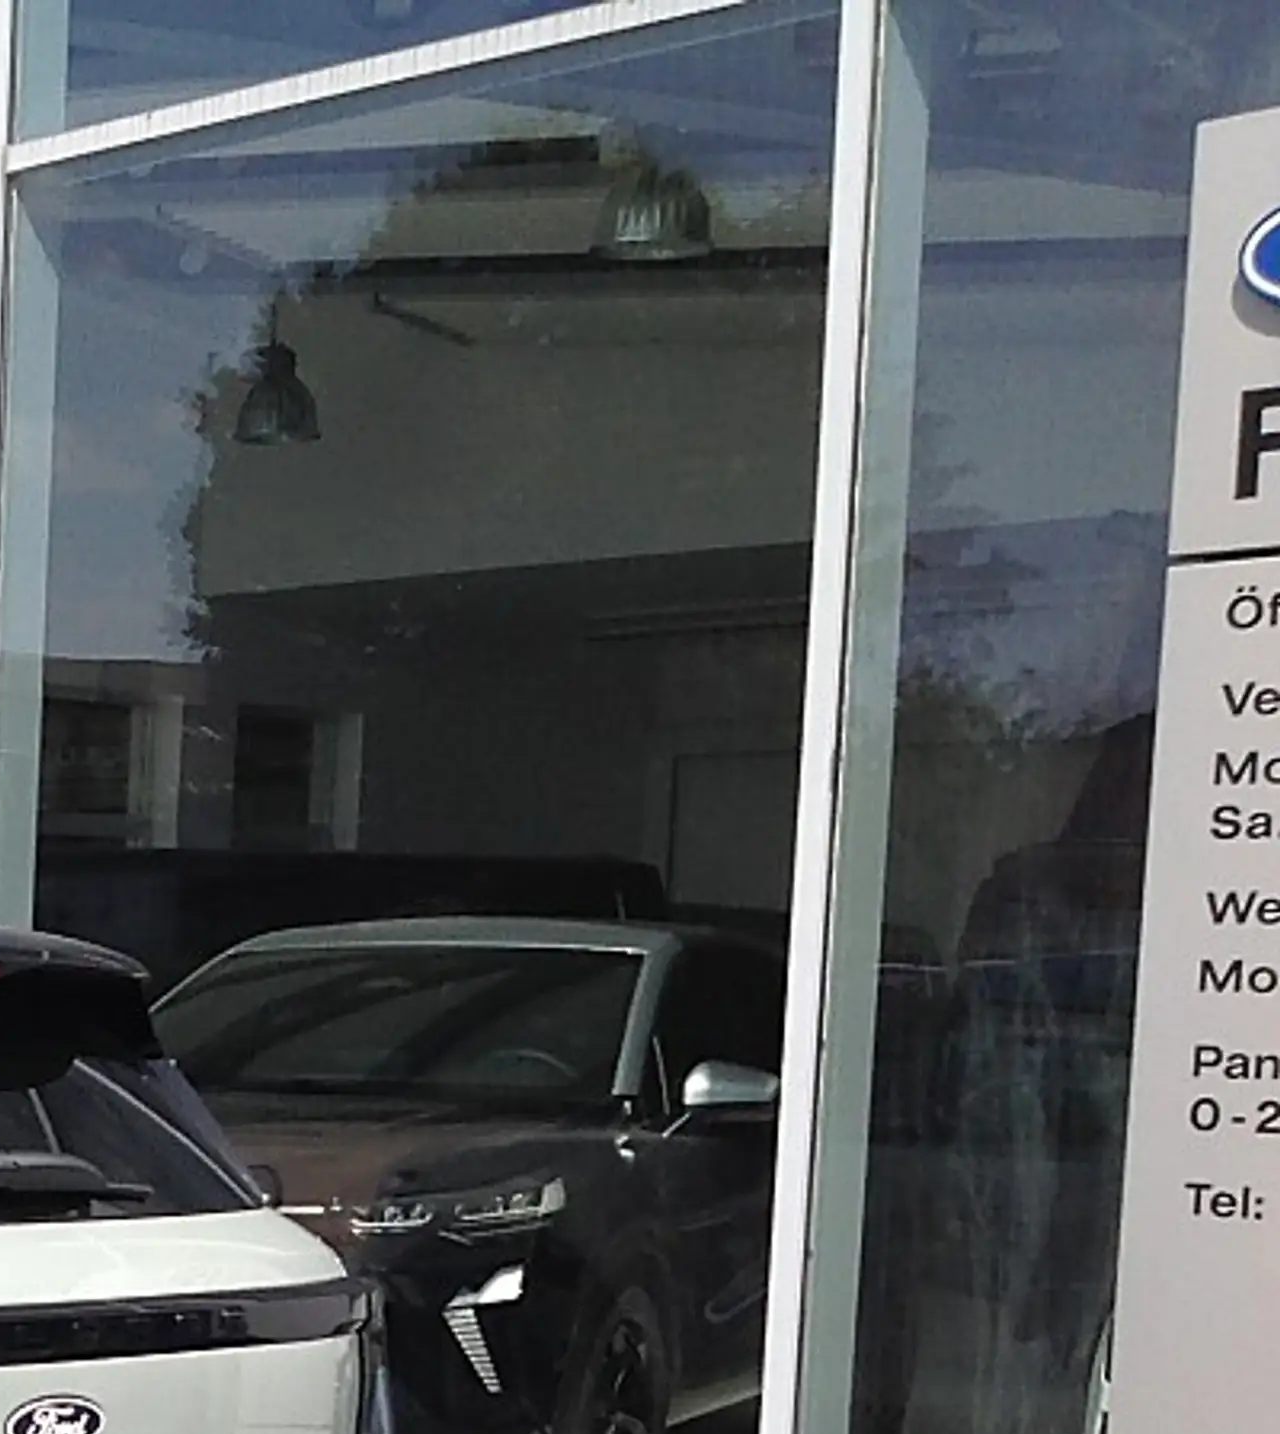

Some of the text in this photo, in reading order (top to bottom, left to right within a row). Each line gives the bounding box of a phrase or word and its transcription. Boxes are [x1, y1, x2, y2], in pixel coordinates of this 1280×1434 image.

[1226, 584, 1280, 629] Öf
[1221, 682, 1280, 717] Ve
[1206, 889, 1280, 926] We
[1199, 960, 1279, 994] Mo
[1192, 1045, 1280, 1080] Pan
[1184, 1182, 1264, 1220] Tel:
